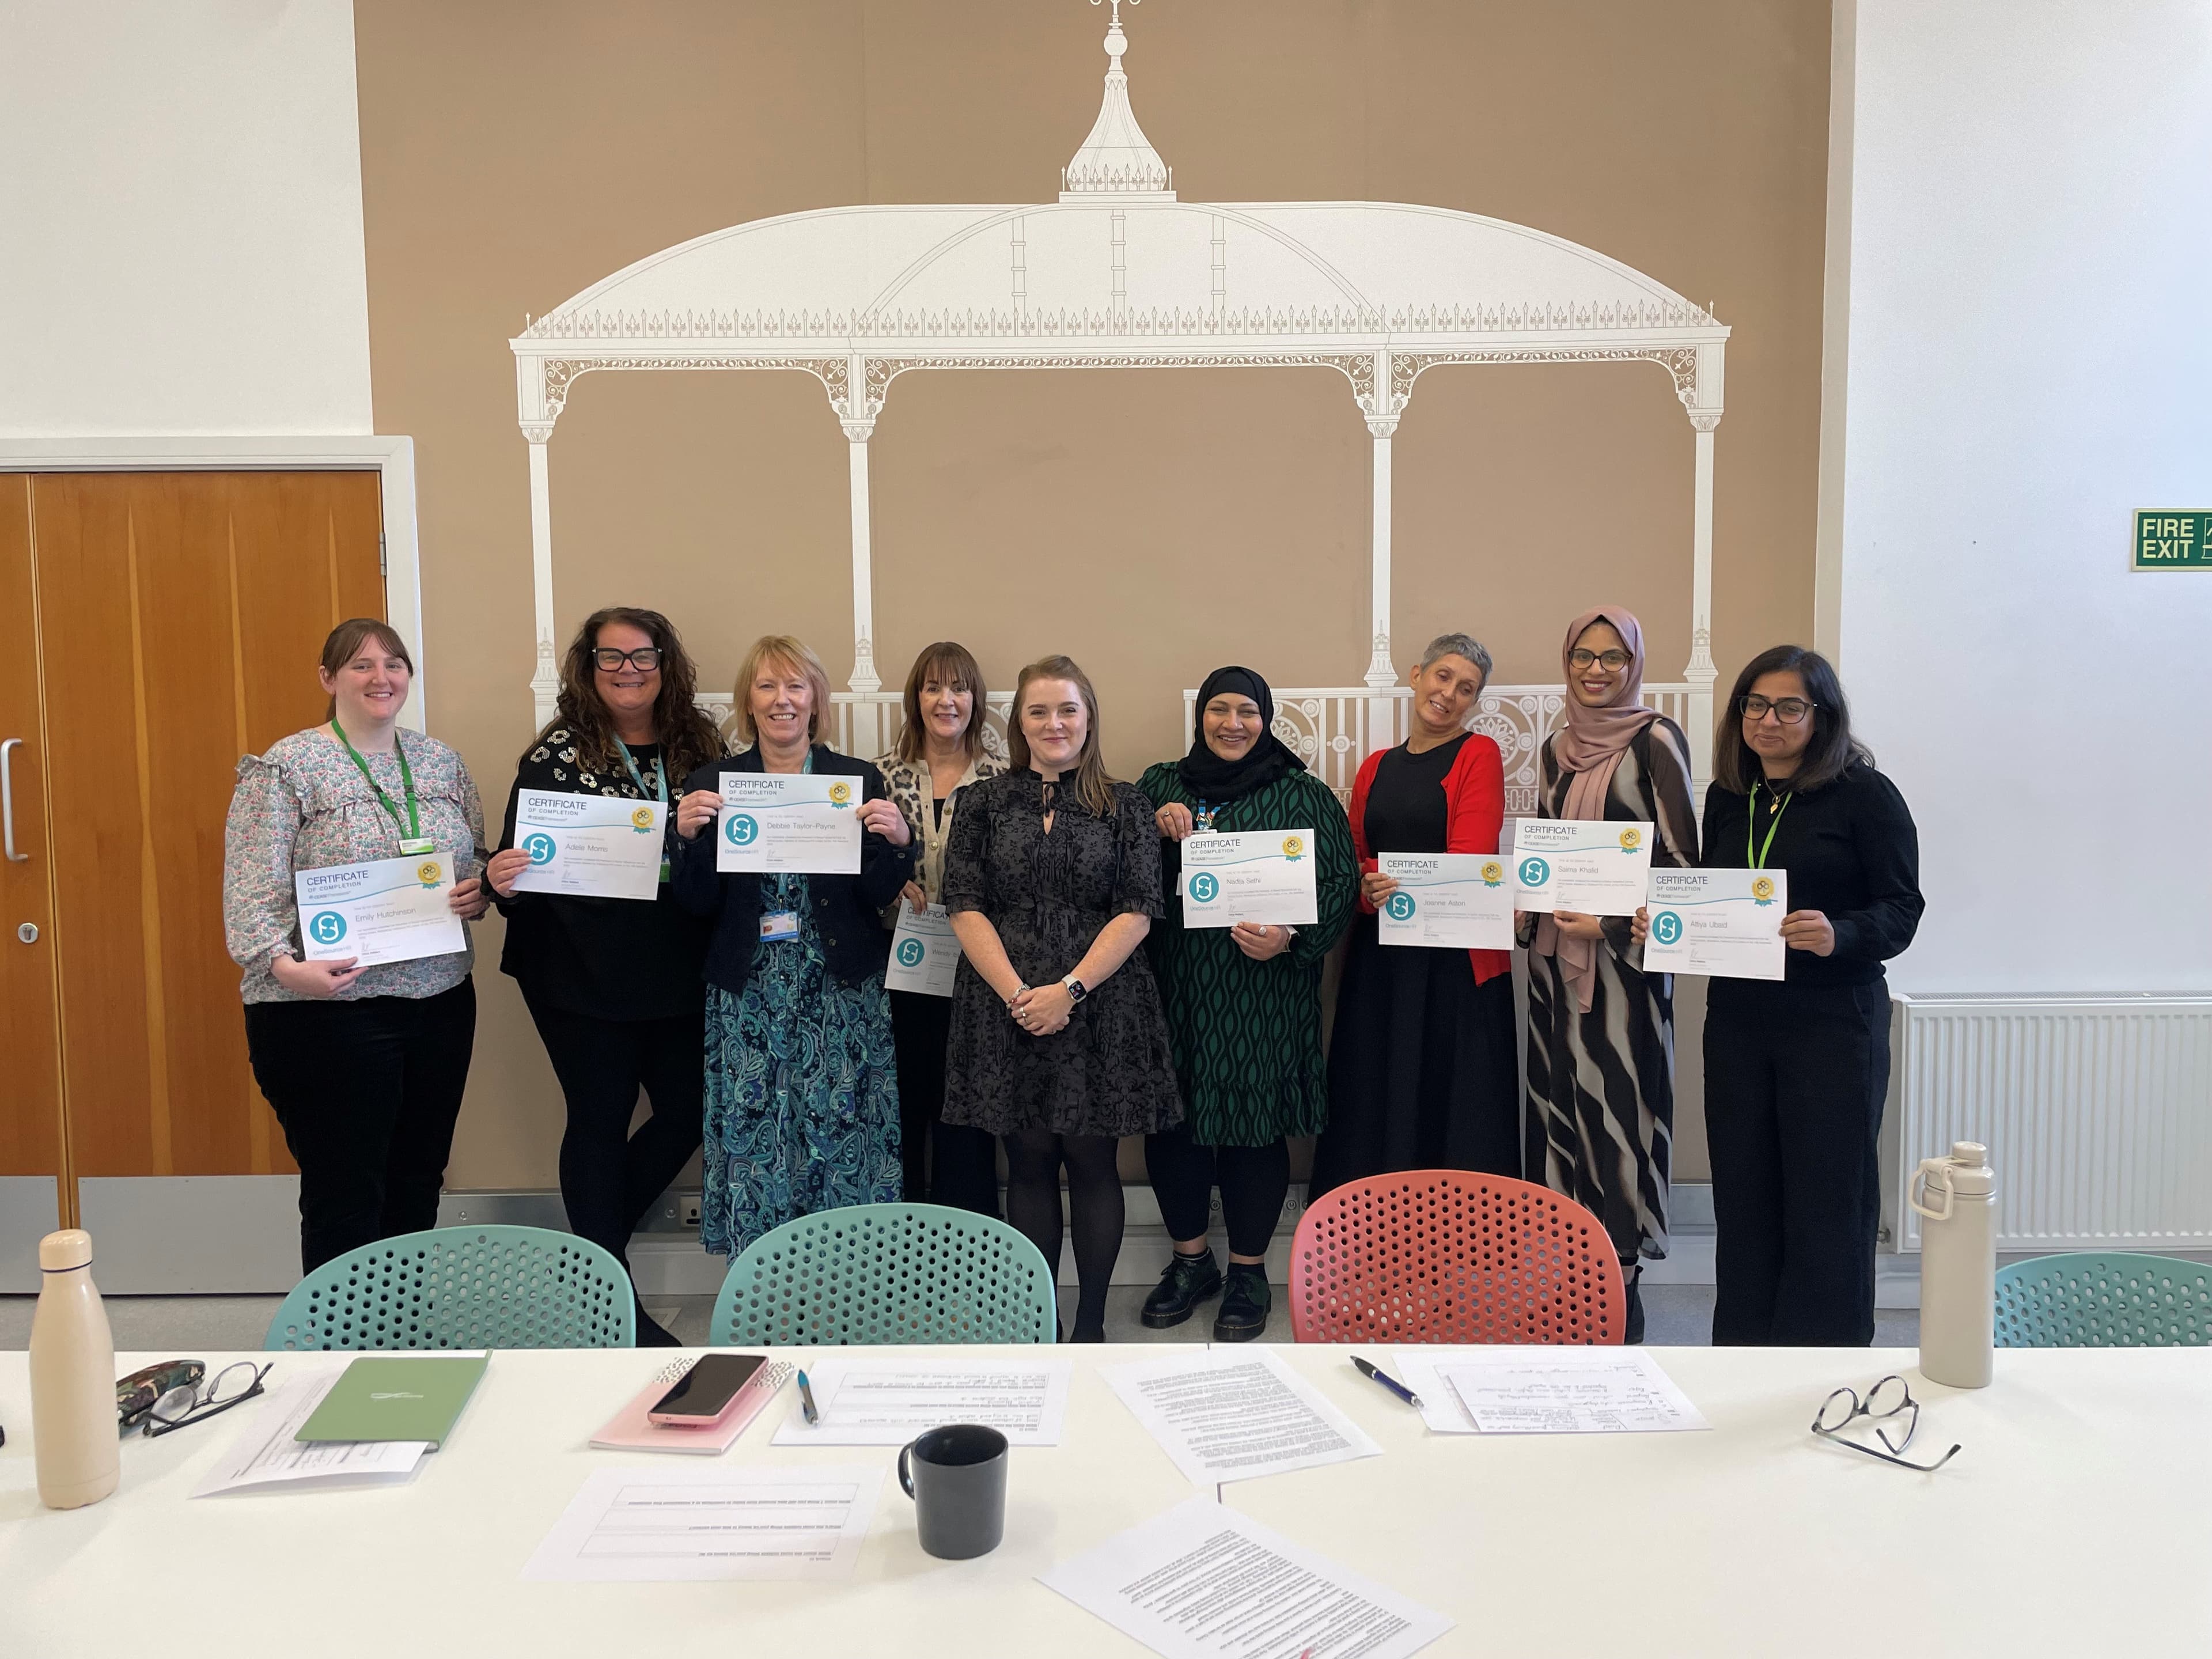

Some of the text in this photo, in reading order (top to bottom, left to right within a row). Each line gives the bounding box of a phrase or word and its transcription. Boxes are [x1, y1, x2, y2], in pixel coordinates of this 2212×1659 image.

[2142, 518, 2194, 537] FIRE
[2142, 540, 2194, 559] EXIT
[729, 780, 785, 789] CERTIFICATE
[528, 798, 587, 810] CERTIFICATE
[1524, 825, 1577, 835] CERTIFICATE
[1190, 839, 1241, 849] CERTIFICATE
[1387, 860, 1438, 868] CERTIFICATE
[306, 870, 369, 887] CERTIFICATE
[1656, 876, 1708, 884] CERTIFICATE
[319, 881, 362, 891] COMPLETION
[355, 908, 416, 922] Emily Hutchinson
[915, 916, 946, 926] COMPLETION
